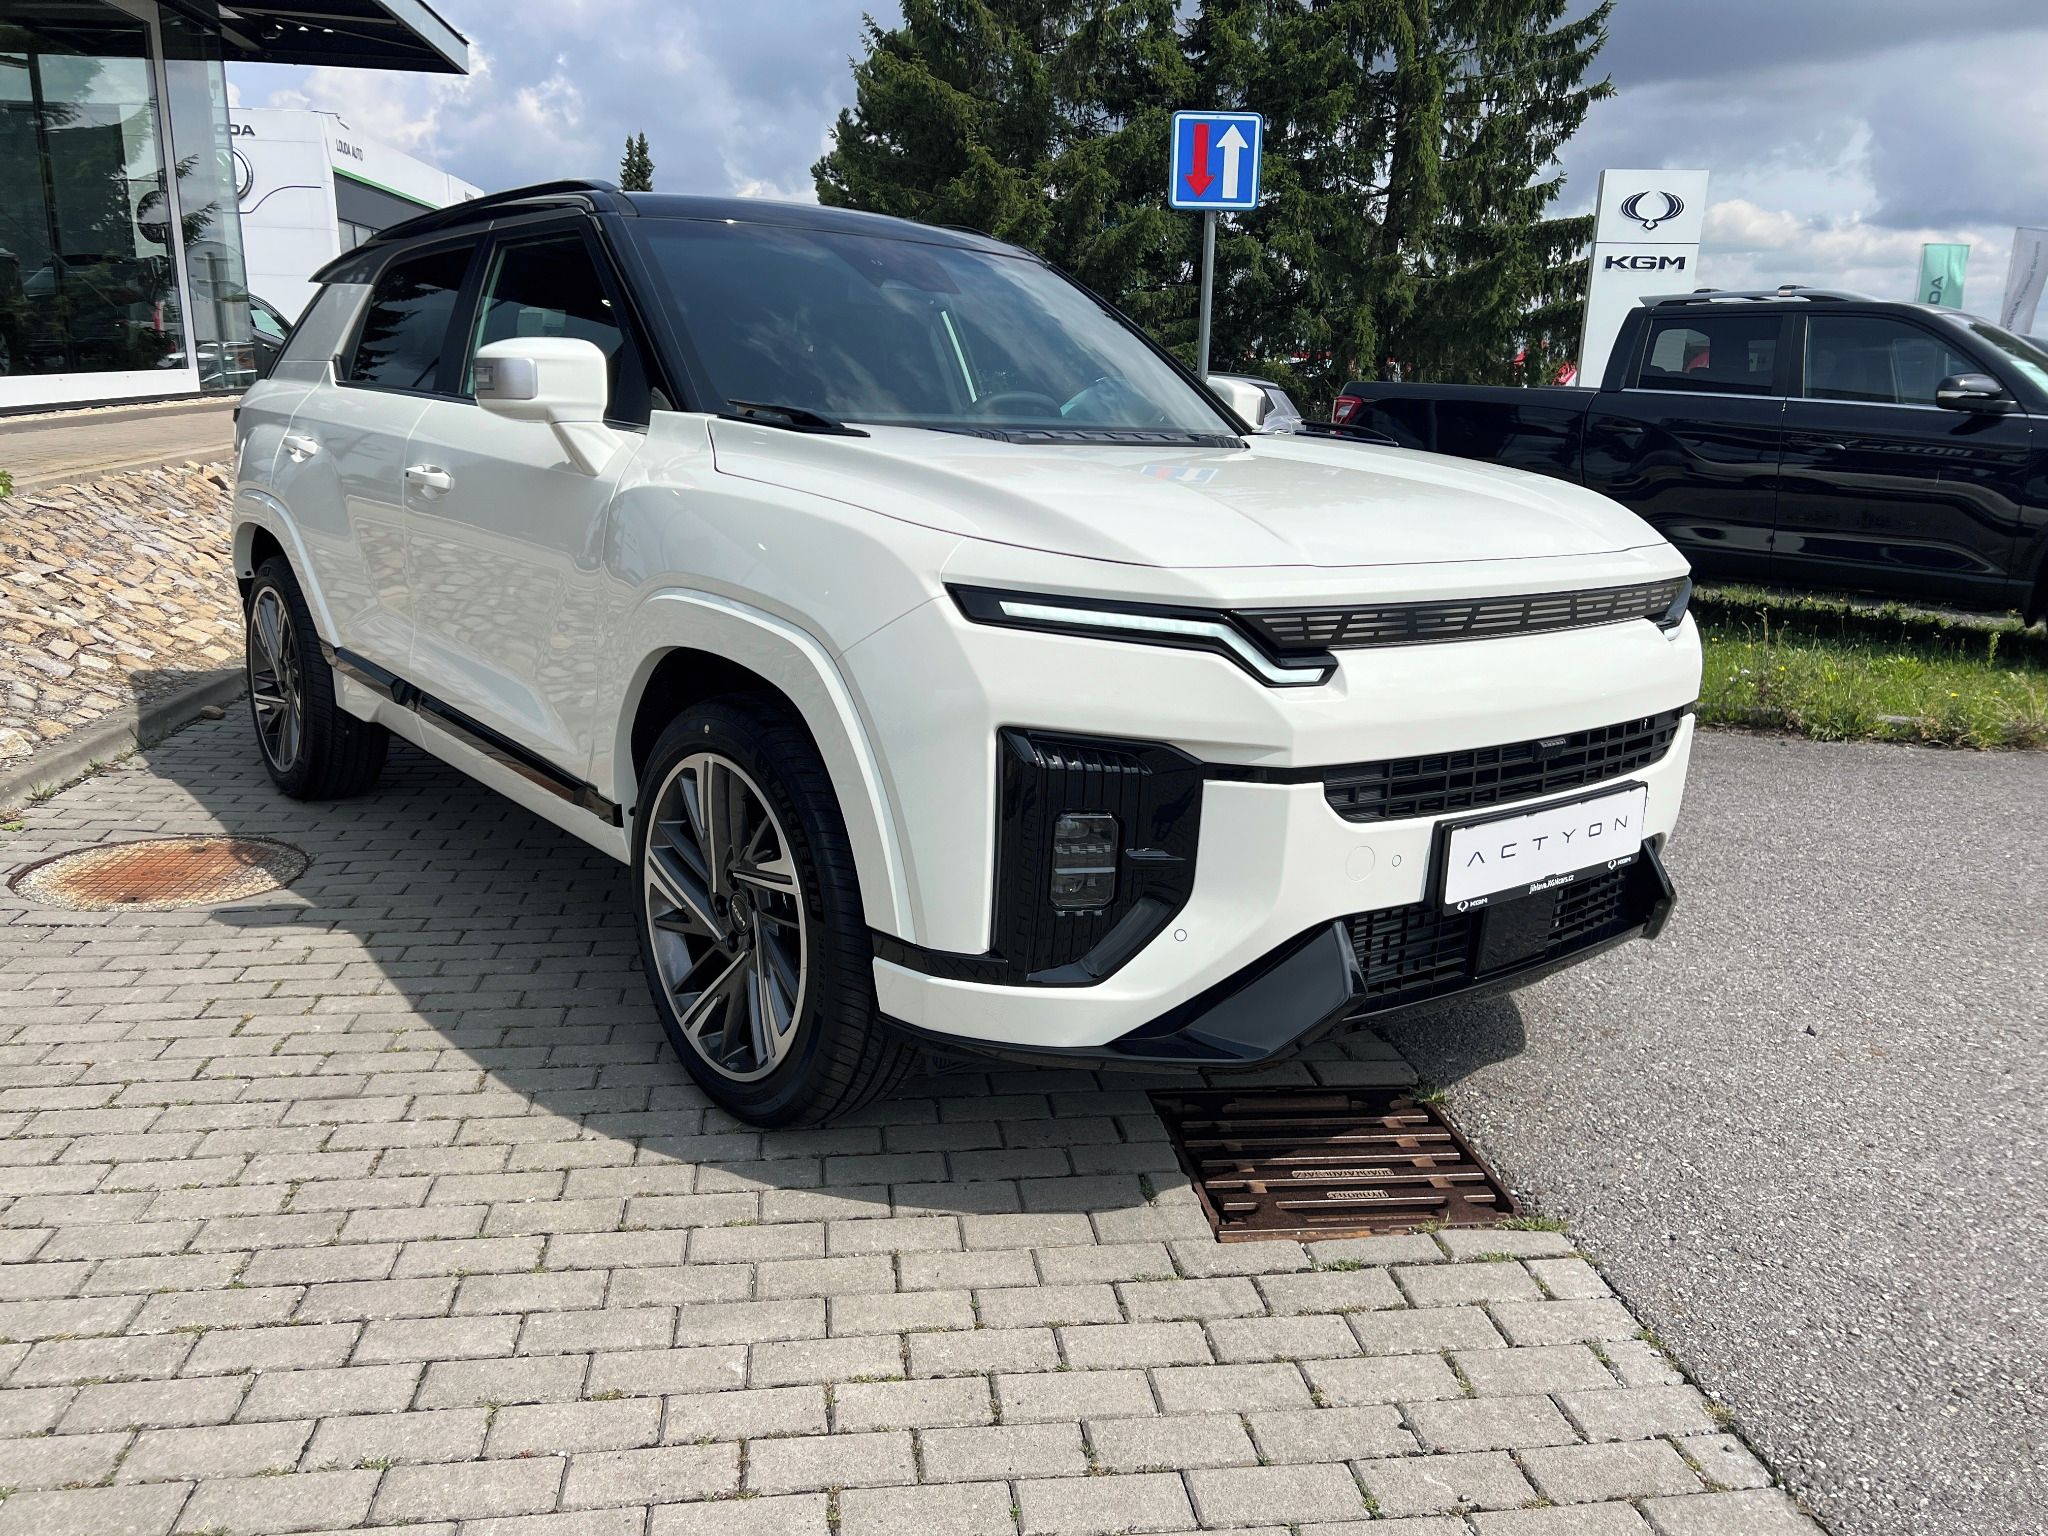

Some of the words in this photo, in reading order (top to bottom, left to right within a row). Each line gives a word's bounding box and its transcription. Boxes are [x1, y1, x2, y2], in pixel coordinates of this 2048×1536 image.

[1604, 255, 1686, 270] KGM
[769, 779, 823, 918] MICHELIN
[1467, 815, 1628, 868] ACTYON
[1470, 897, 1488, 907] KGM
